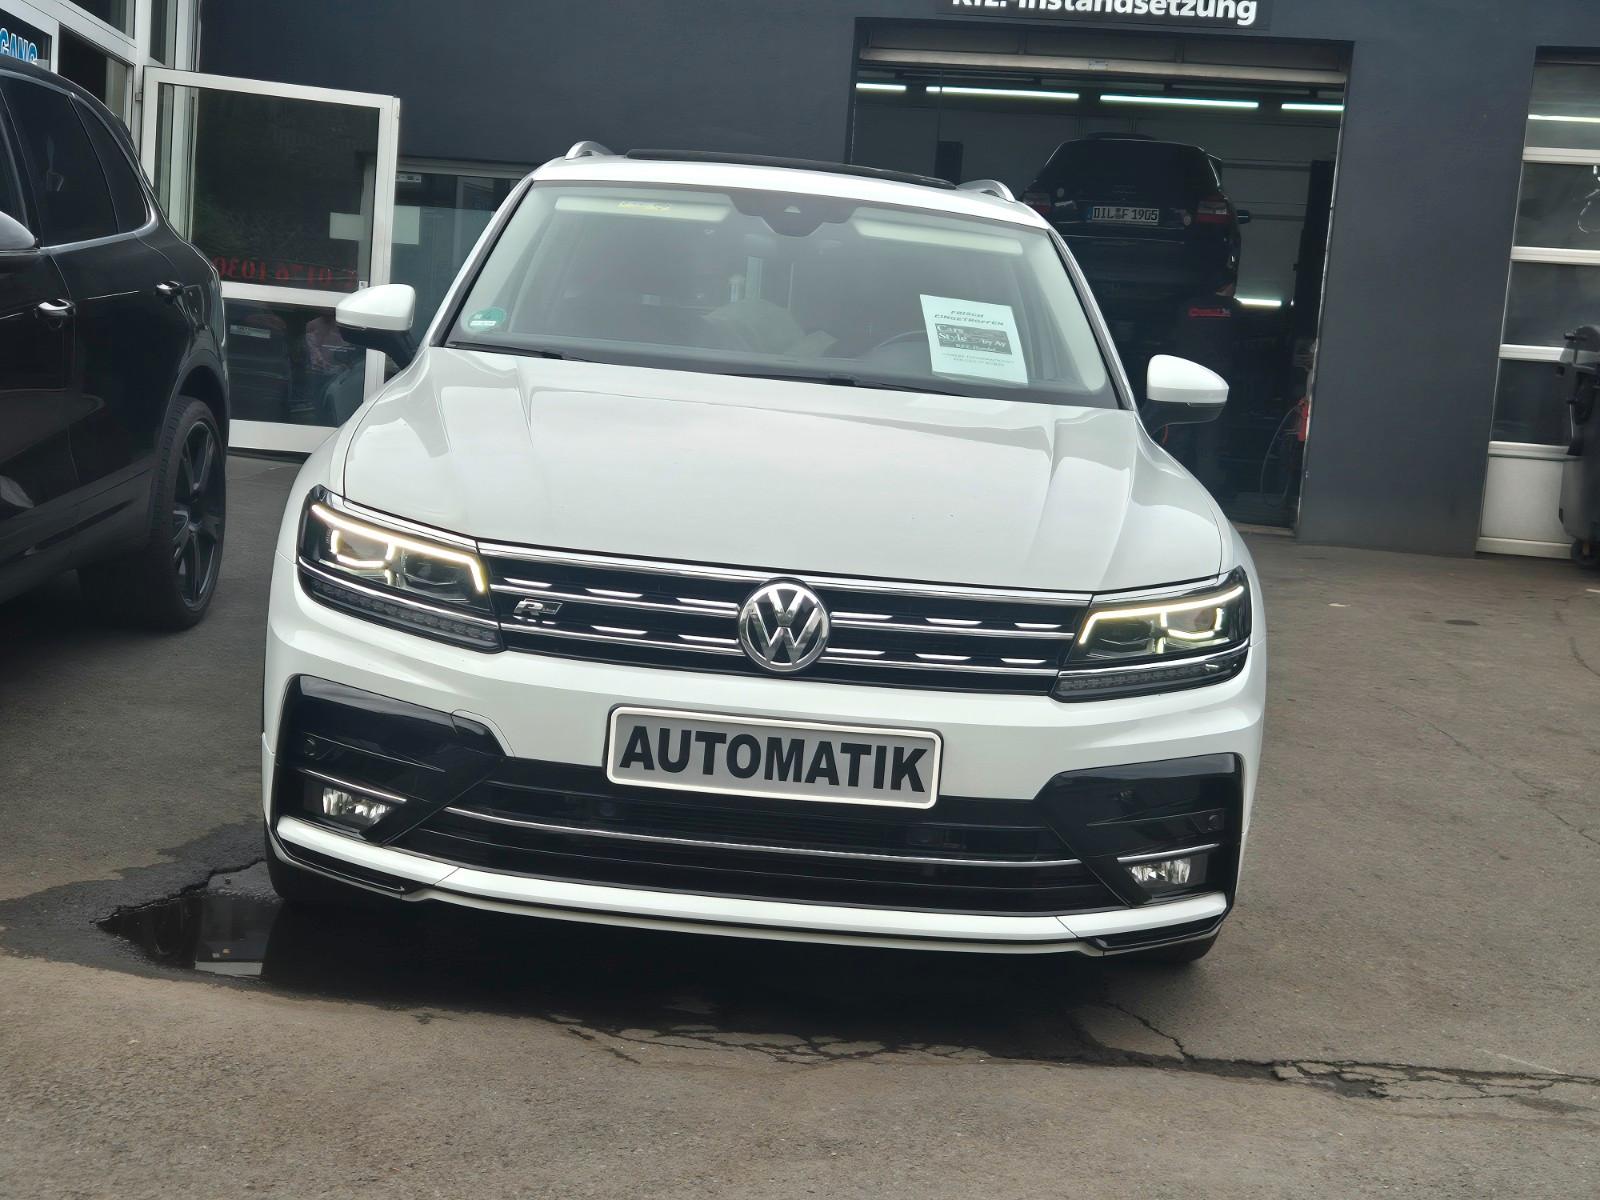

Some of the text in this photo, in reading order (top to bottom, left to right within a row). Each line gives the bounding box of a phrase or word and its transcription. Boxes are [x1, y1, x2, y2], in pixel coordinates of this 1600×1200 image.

[951, 0, 1257, 25] .nstandsetzung
[1094, 207, 1158, 221] DIL F 1905
[619, 726, 928, 792] AUTOMATIK
